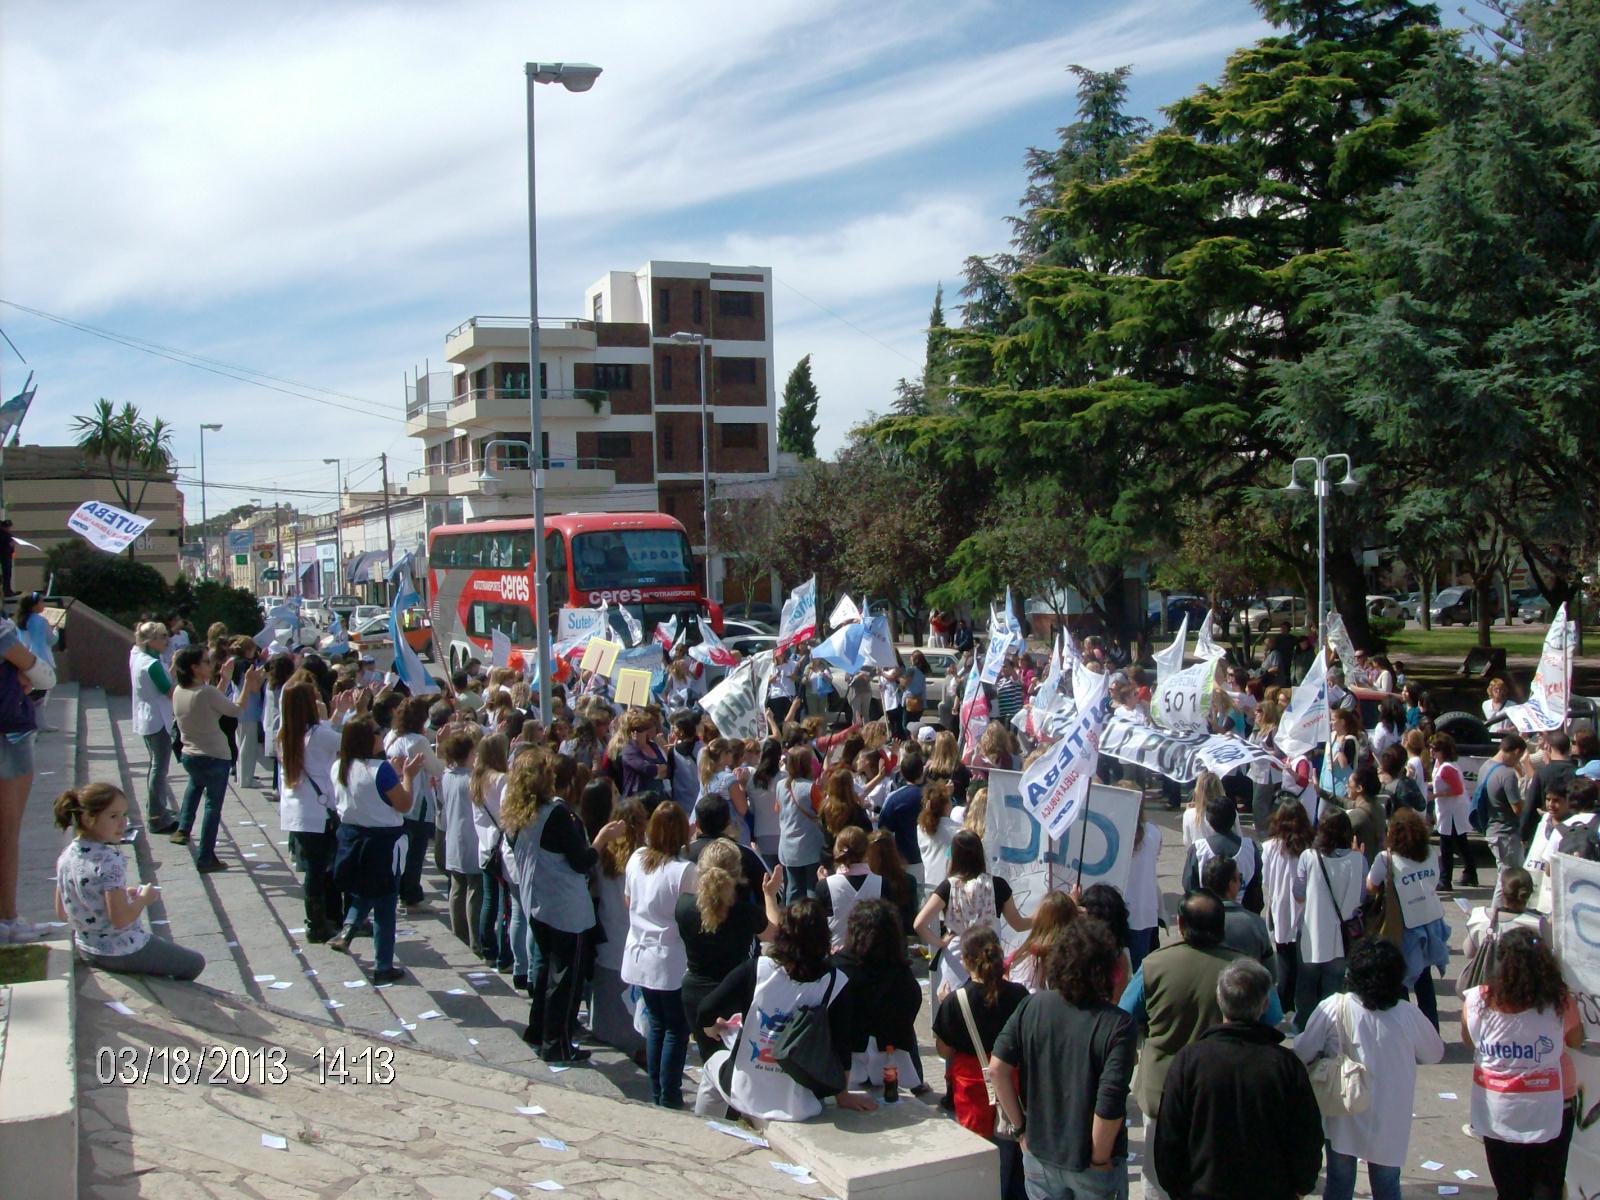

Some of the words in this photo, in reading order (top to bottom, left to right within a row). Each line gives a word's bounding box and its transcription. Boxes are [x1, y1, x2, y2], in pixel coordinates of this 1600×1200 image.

[501, 574, 530, 601] ceres
[589, 589, 641, 604] ceres
[1401, 869, 1436, 886] CTERA
